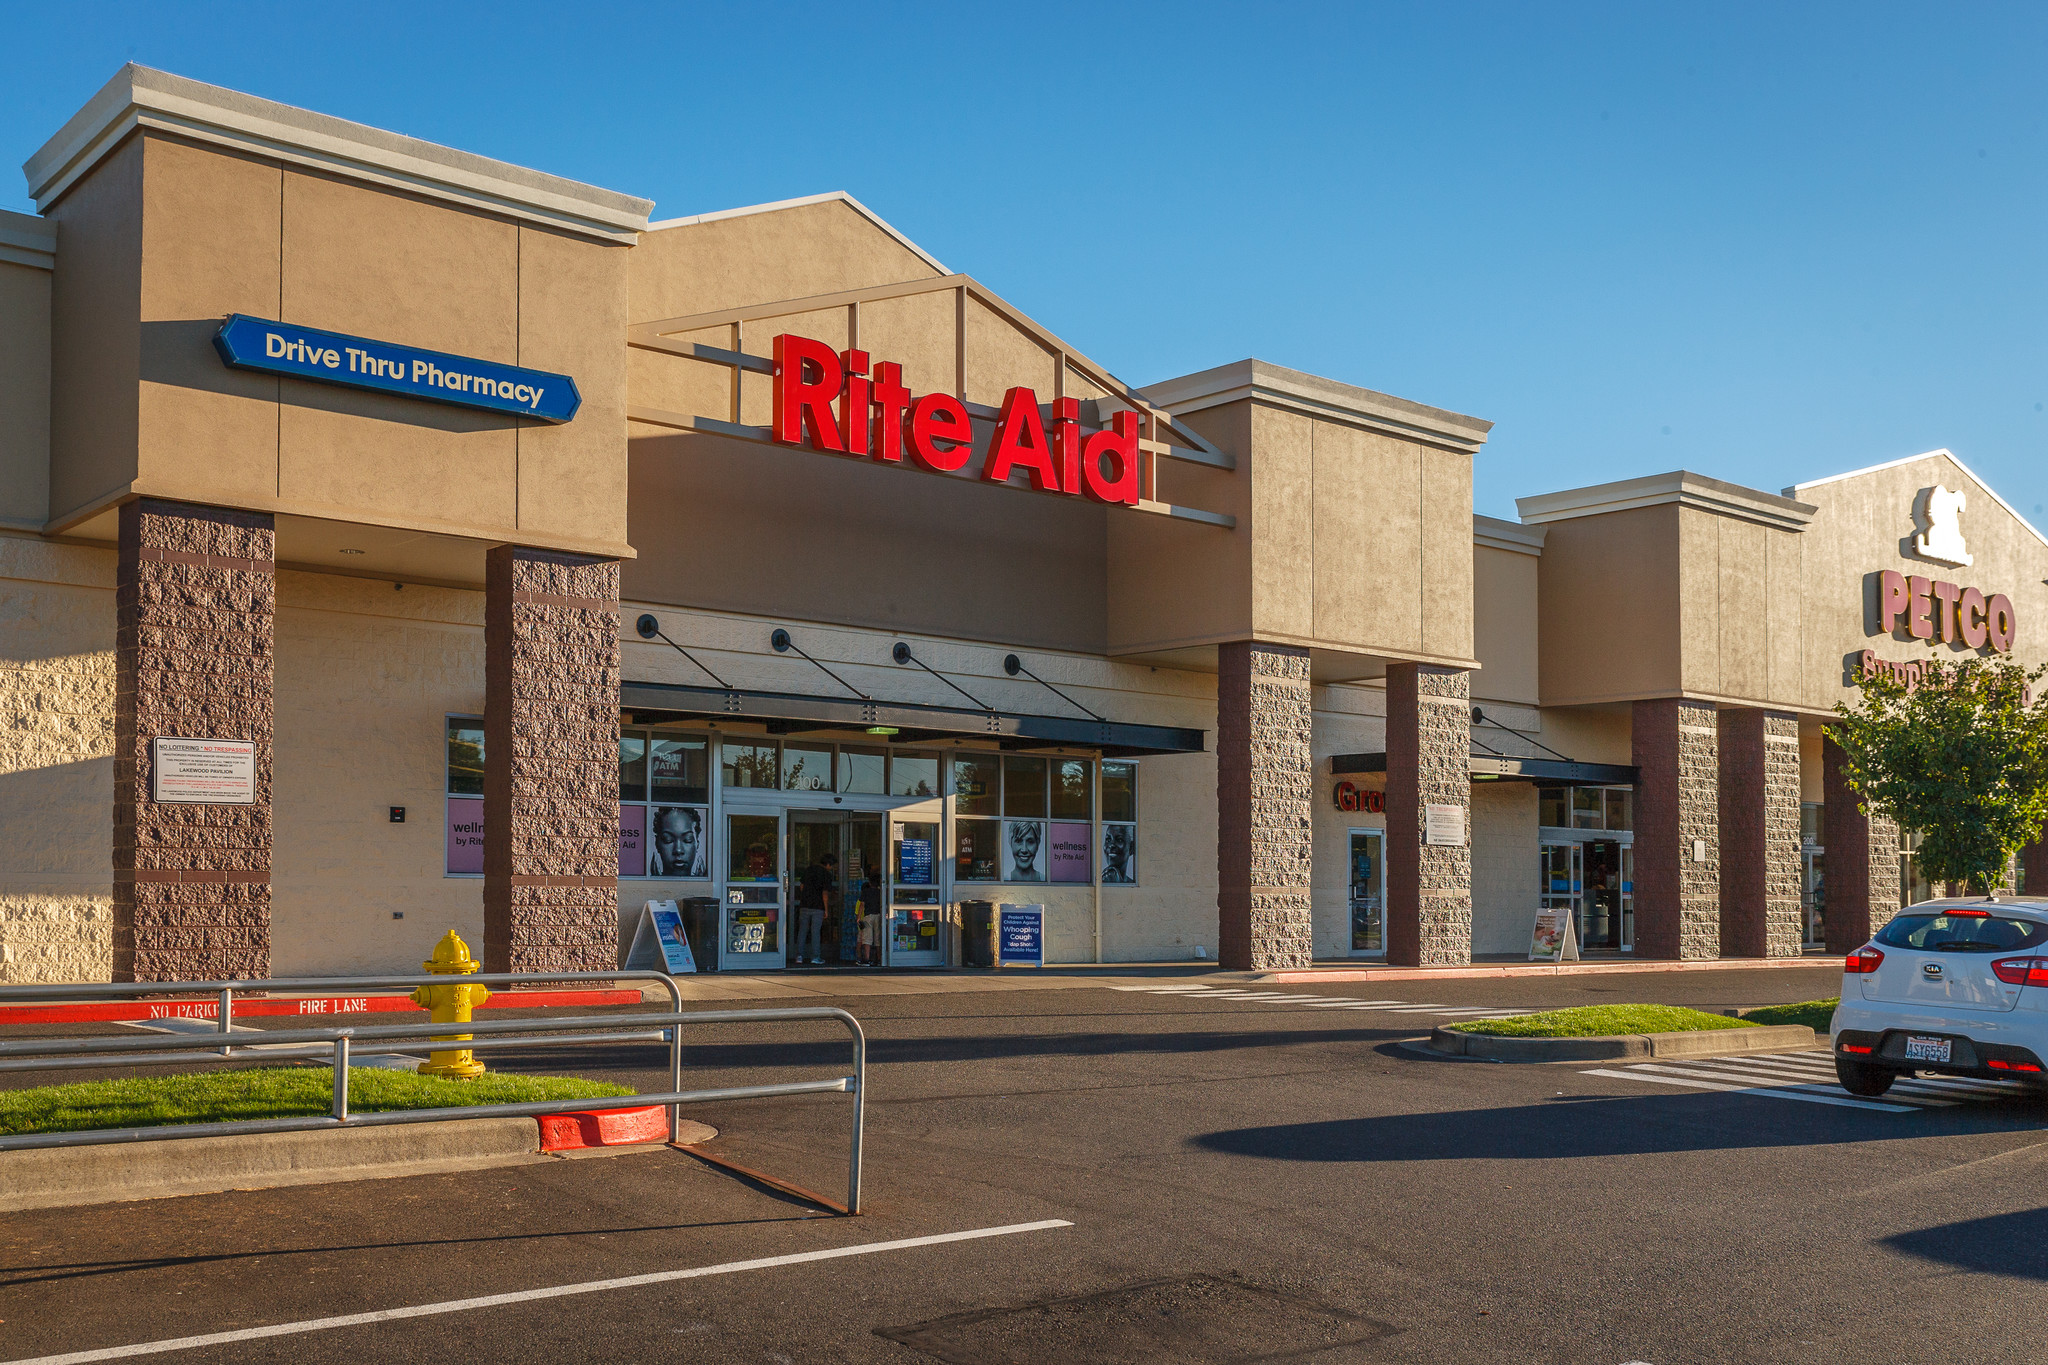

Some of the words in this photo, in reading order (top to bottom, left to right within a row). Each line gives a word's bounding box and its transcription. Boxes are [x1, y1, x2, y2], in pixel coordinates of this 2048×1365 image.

[266, 332, 341, 368] Drive
[345, 346, 405, 380] Thru
[412, 360, 544, 408] Pharmacy
[773, 333, 975, 472] Rite
[981, 386, 1140, 506] Aid
[1880, 569, 2016, 653] PETCO
[660, 762, 679, 770] ATM
[1338, 782, 1384, 813] Gro
[453, 822, 484, 833] welln
[620, 828, 639, 837] ess
[456, 837, 466, 846] by
[1053, 841, 1087, 850] wellness
[150, 1005, 169, 1018] NO
[178, 1003, 236, 1018] PARKI
[300, 1000, 327, 1014] FIRE
[334, 998, 368, 1014] LANE
[1906, 1044, 1948, 1058] ASY6558
